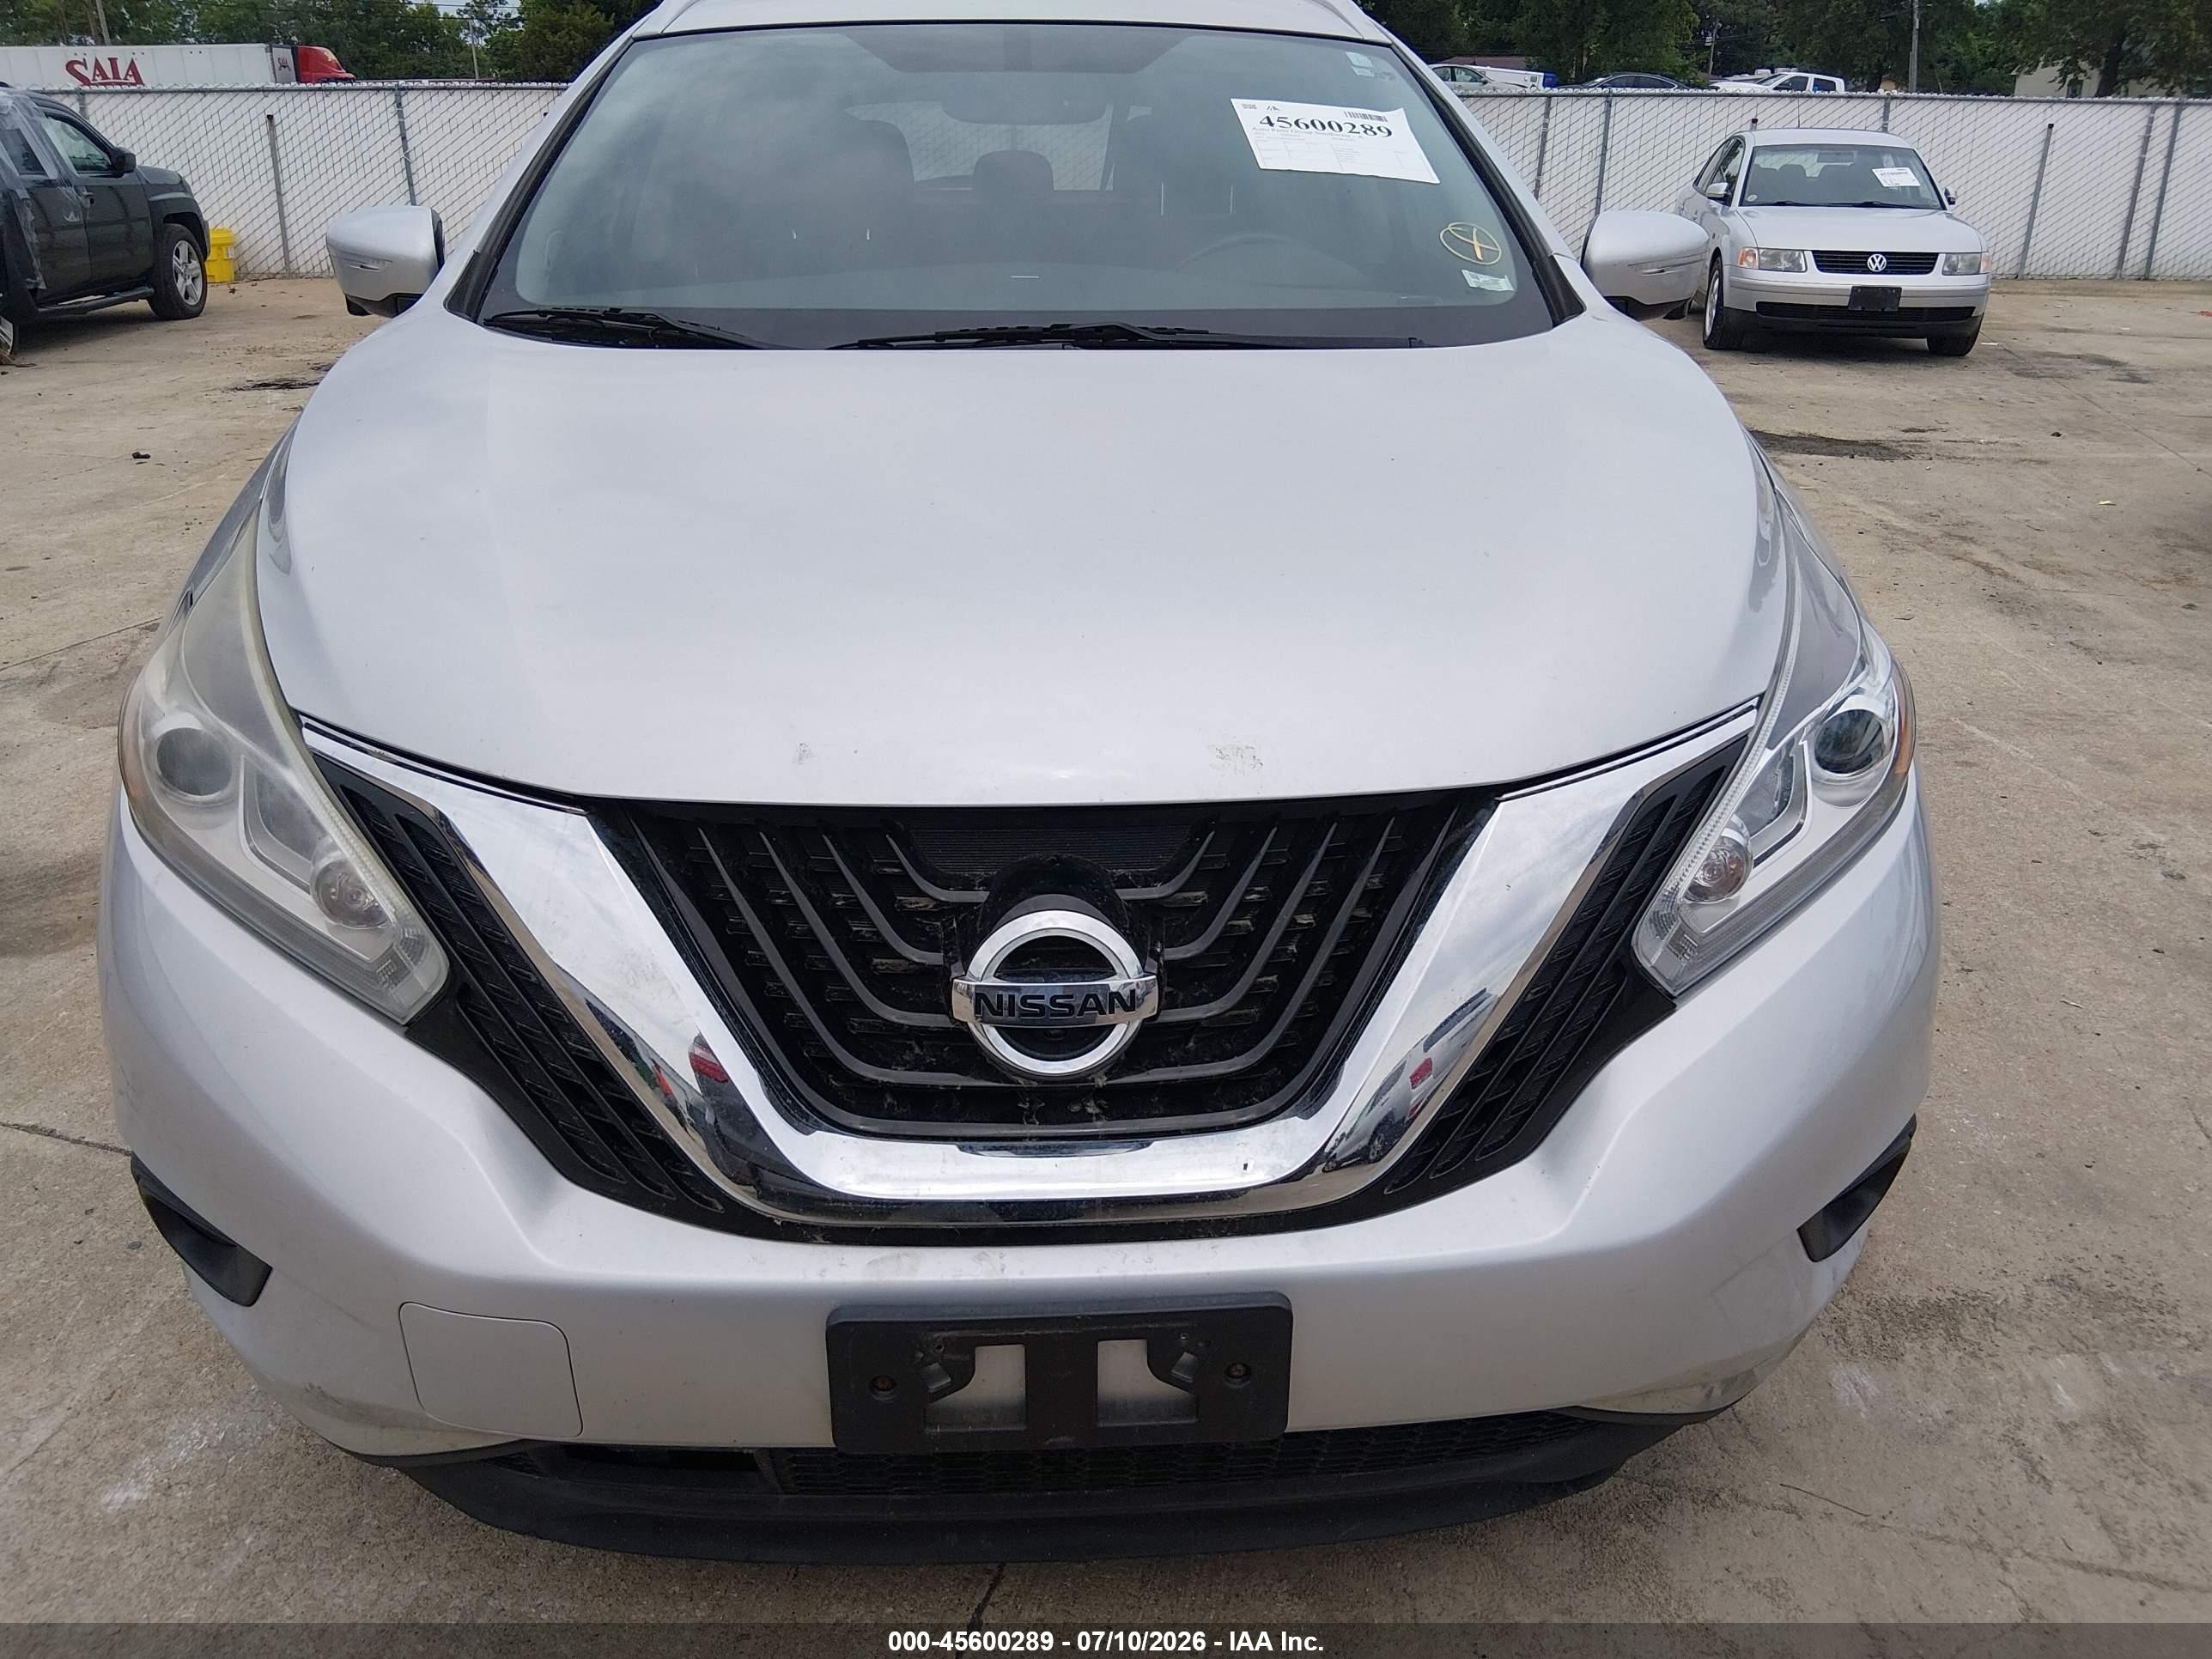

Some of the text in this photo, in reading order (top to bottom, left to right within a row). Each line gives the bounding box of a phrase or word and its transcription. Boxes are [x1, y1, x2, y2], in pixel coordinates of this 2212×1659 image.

[65, 56, 145, 87] SAIA
[1259, 114, 1393, 138] 45600289
[974, 988, 1138, 1019] NISSAN
